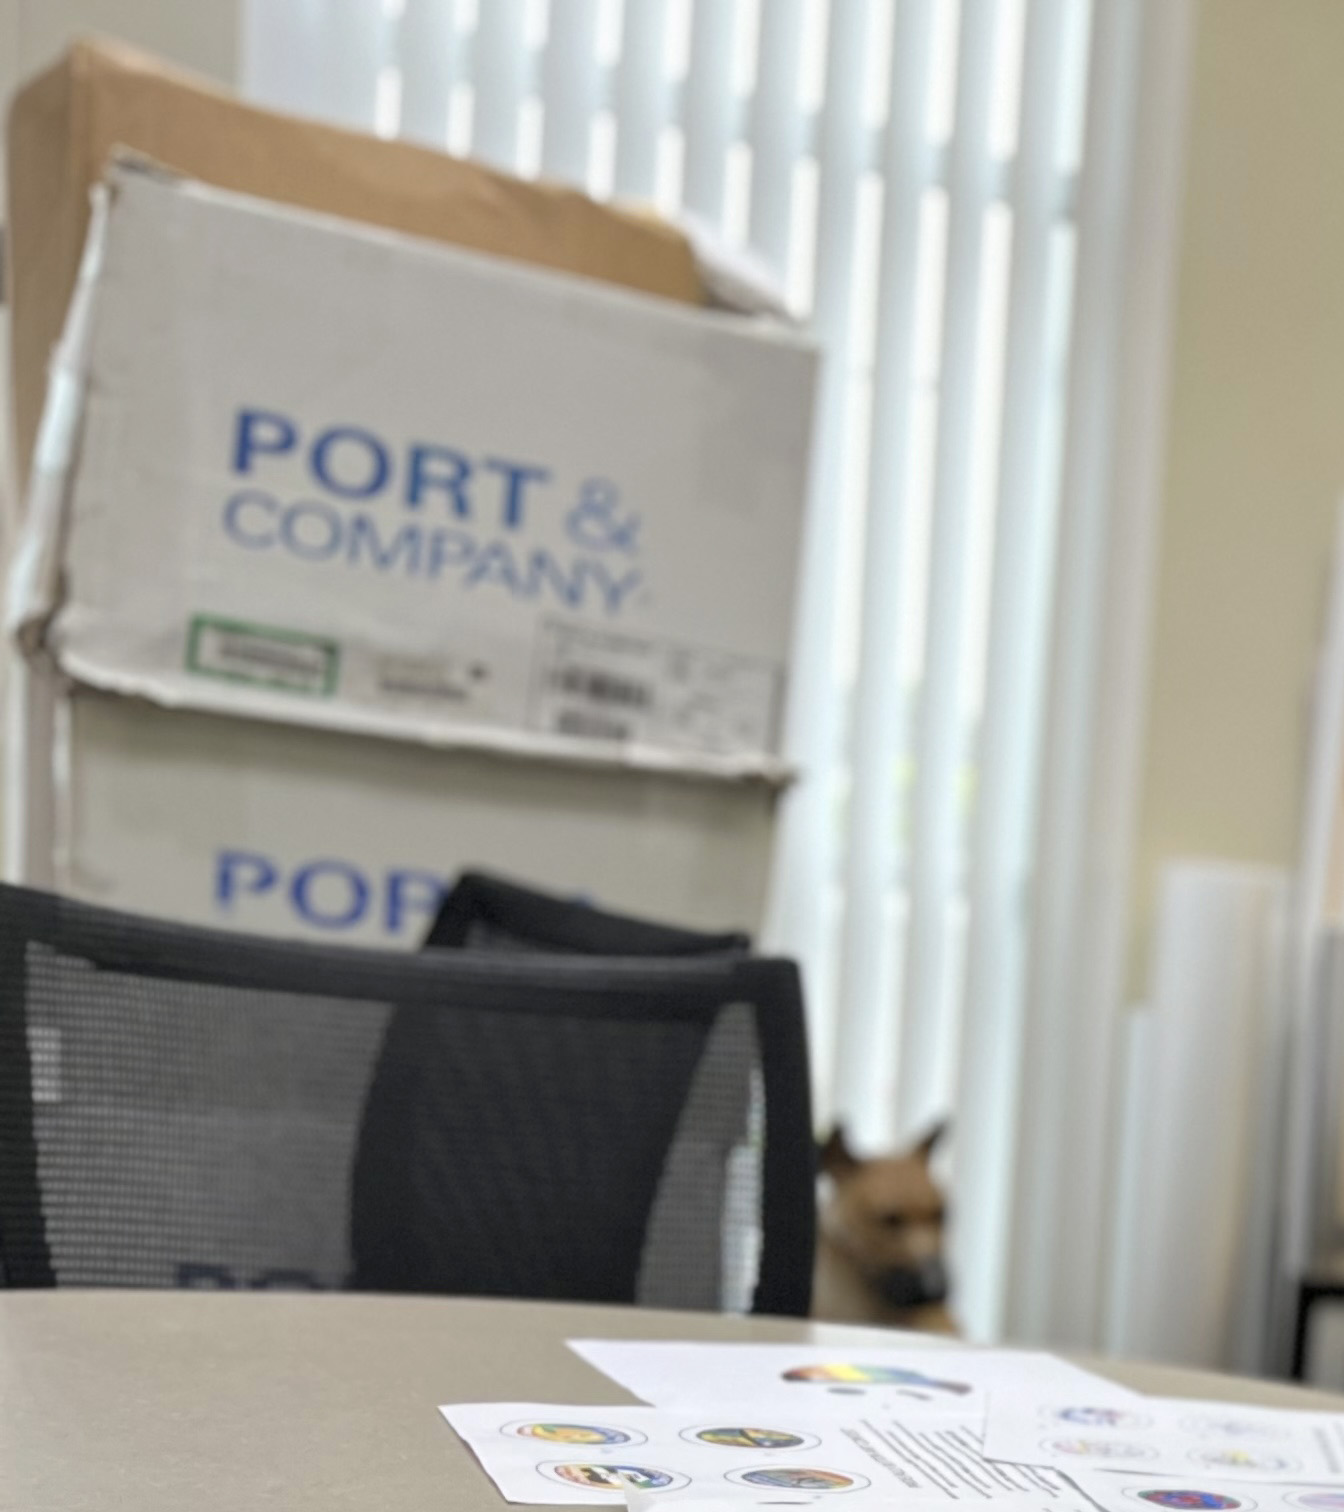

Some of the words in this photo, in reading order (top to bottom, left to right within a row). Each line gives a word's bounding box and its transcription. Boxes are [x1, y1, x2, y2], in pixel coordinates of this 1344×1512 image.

[232, 409, 549, 532] PORT
[565, 476, 640, 556] &
[222, 490, 641, 615] COMPANY
[214, 851, 450, 944] POR
